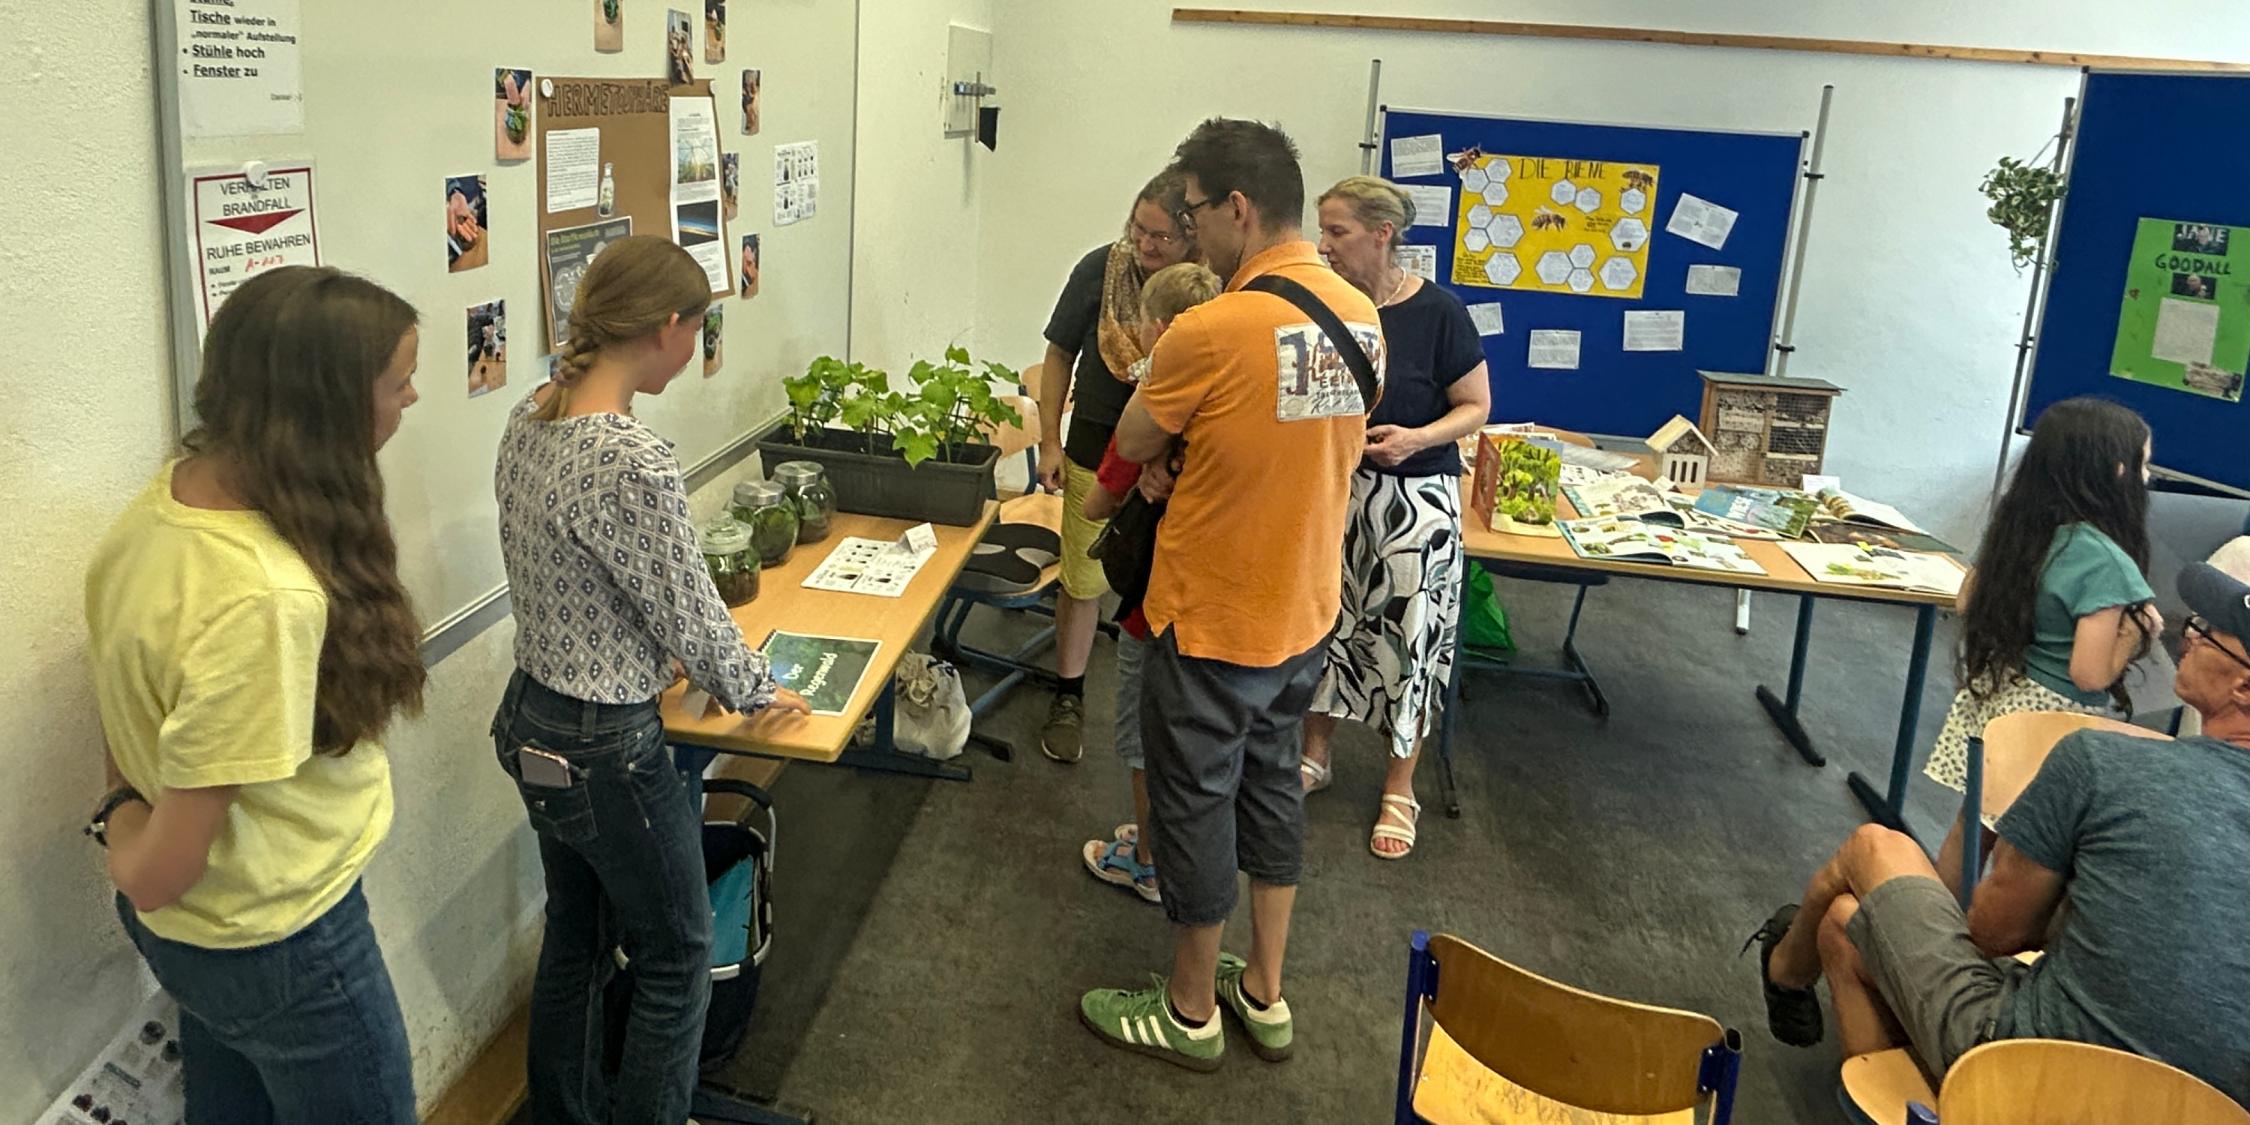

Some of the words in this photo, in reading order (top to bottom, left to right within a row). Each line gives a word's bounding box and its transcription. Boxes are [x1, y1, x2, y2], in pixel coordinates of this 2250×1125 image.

[190, 10, 231, 25] Tische
[233, 16, 265, 26] wieder
[267, 17, 276, 26] in
[246, 32, 296, 44] Aufstellung
[192, 44, 233, 58] Stühle
[236, 46, 265, 58] hoch
[193, 64, 241, 78] Fenster
[244, 67, 258, 77] zu
[1519, 158, 1553, 179] DIE
[220, 178, 290, 195] VERLTEN
[223, 198, 291, 216] BRANDFALL
[2176, 224, 2227, 243] JANE
[206, 244, 243, 260] RUHE
[245, 234, 311, 254] BEWAHREN
[2155, 253, 2232, 275] GOODALL
[781, 663, 804, 680] Der
[799, 652, 838, 697] Regenwald
